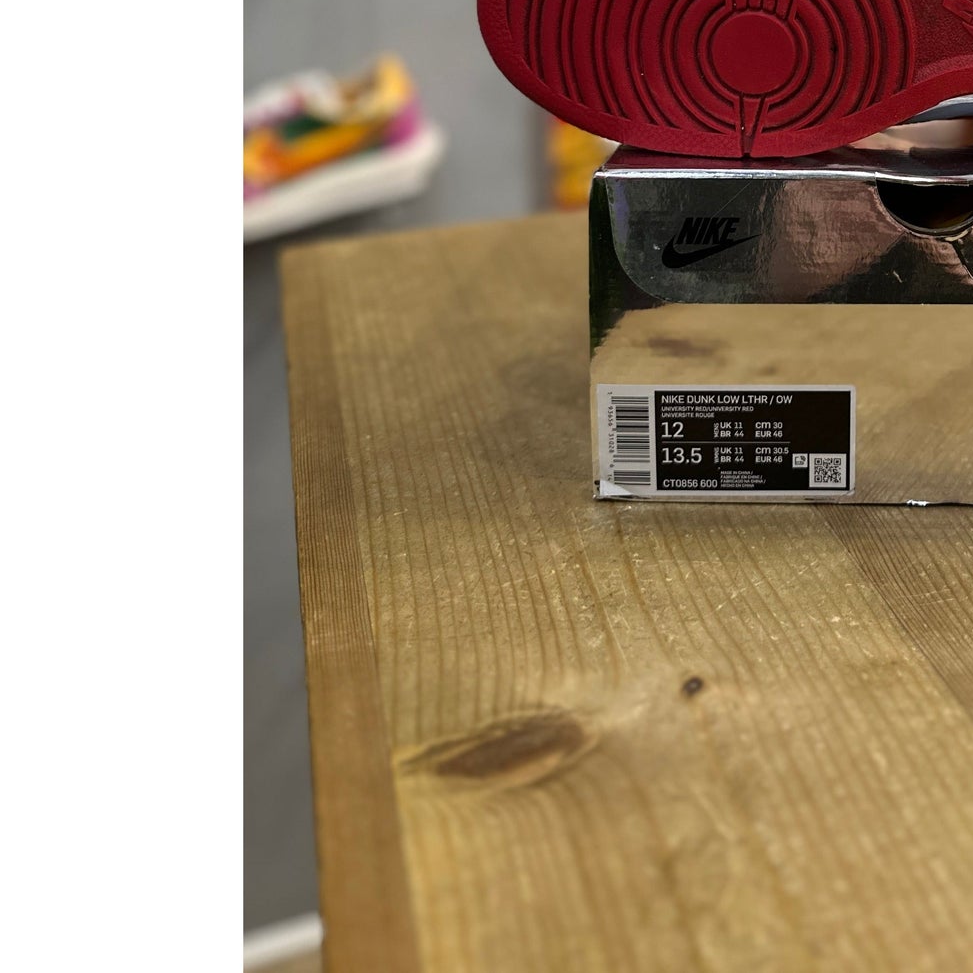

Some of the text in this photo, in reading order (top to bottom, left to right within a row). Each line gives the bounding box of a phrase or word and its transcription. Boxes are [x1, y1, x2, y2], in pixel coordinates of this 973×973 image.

[676, 217, 740, 245] NIKE
[661, 395, 793, 406] NIKE DUNK LOW LTHR / OW
[661, 421, 684, 438] 12
[720, 430, 744, 438] BR 44
[755, 430, 783, 438] EUR 46
[662, 447, 702, 464] 13.5
[720, 455, 744, 463] BR 44
[755, 455, 783, 463] EUR 46
[663, 479, 718, 488] CT0856 600
